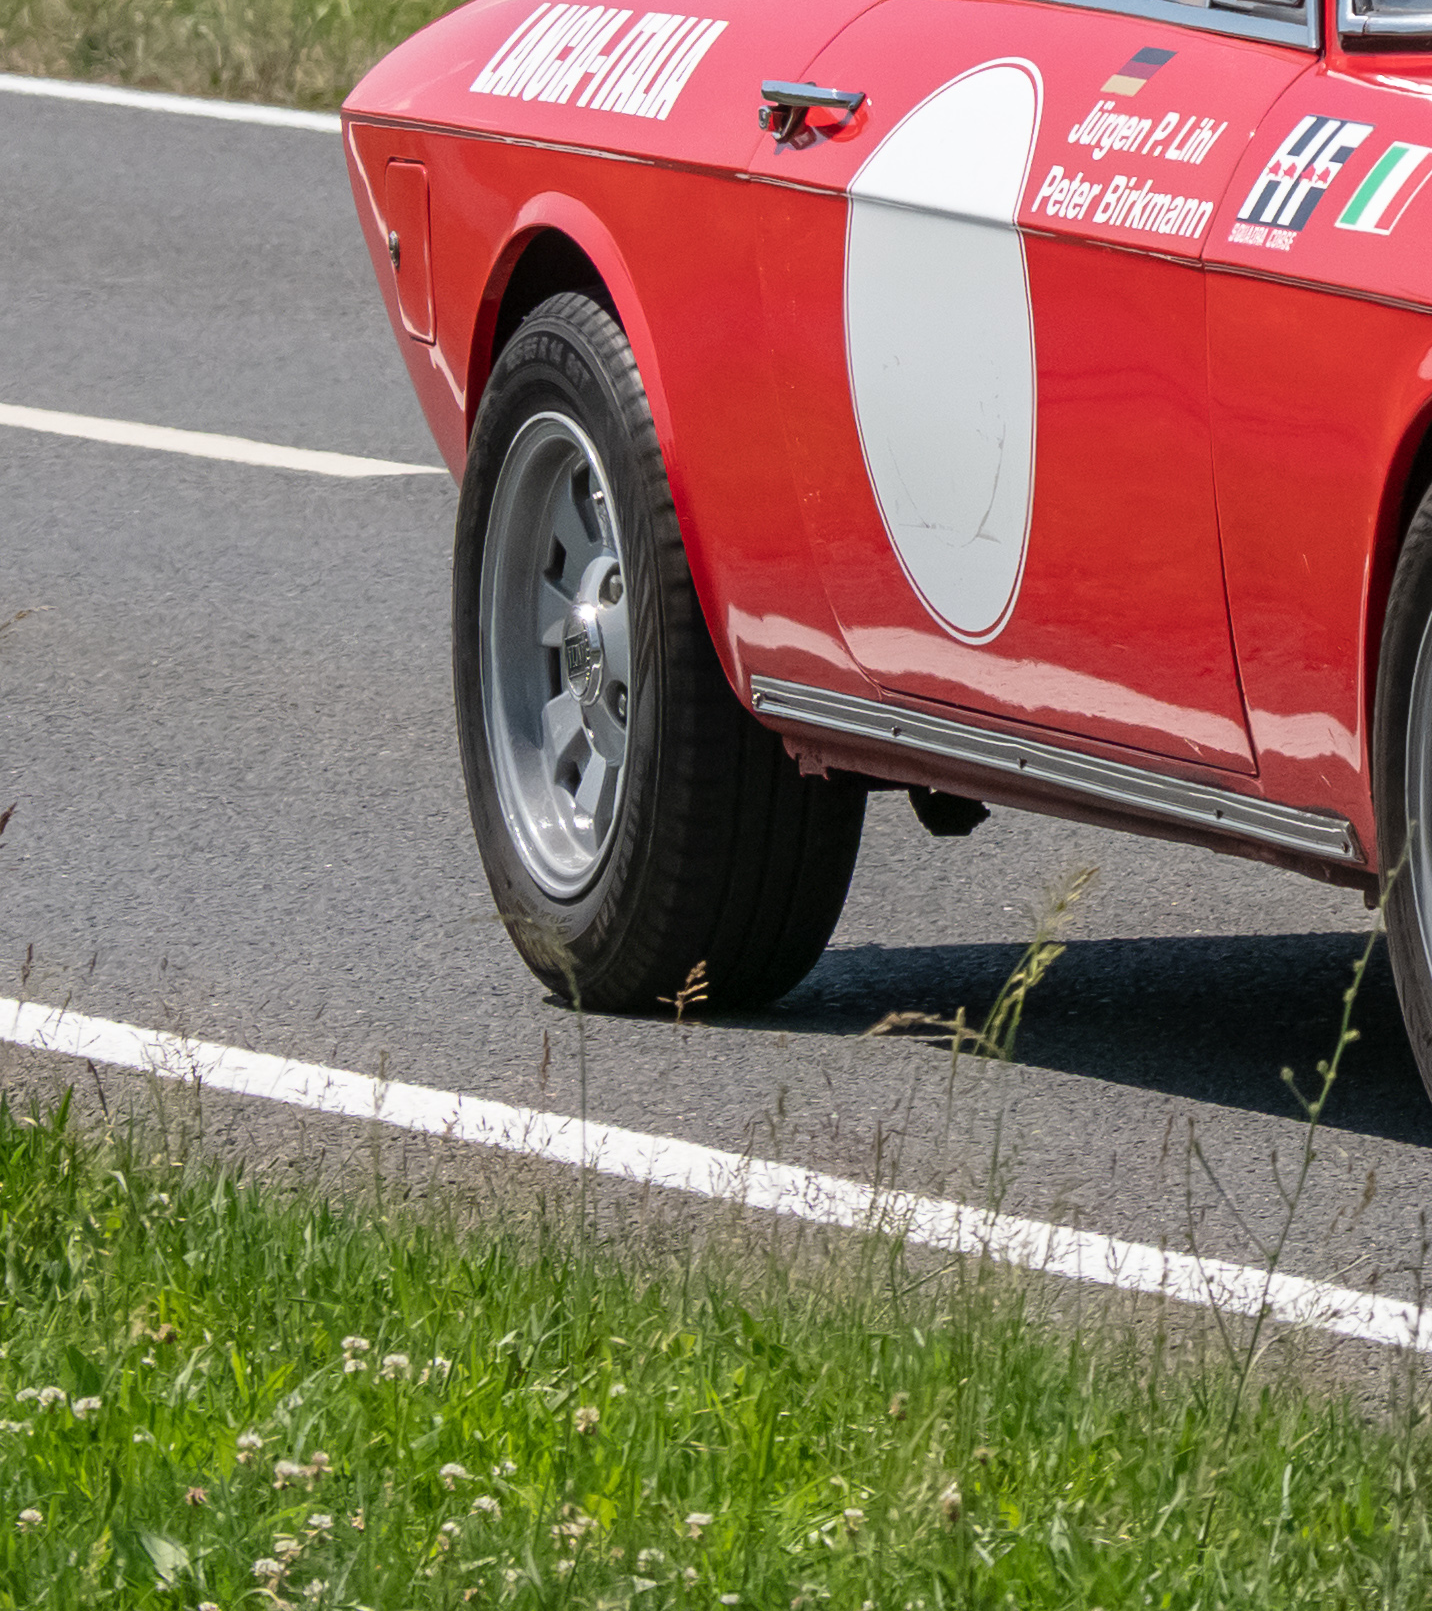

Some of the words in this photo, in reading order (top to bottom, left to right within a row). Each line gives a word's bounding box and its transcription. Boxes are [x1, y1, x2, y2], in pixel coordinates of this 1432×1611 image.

[469, 3, 729, 120] LANCIA-ITALIA
[1067, 100, 1152, 160] Jürgen
[1141, 112, 1180, 157] P.
[1164, 115, 1229, 165] Lihl
[1031, 165, 1103, 220] Peter
[1092, 174, 1214, 239] Birkmann
